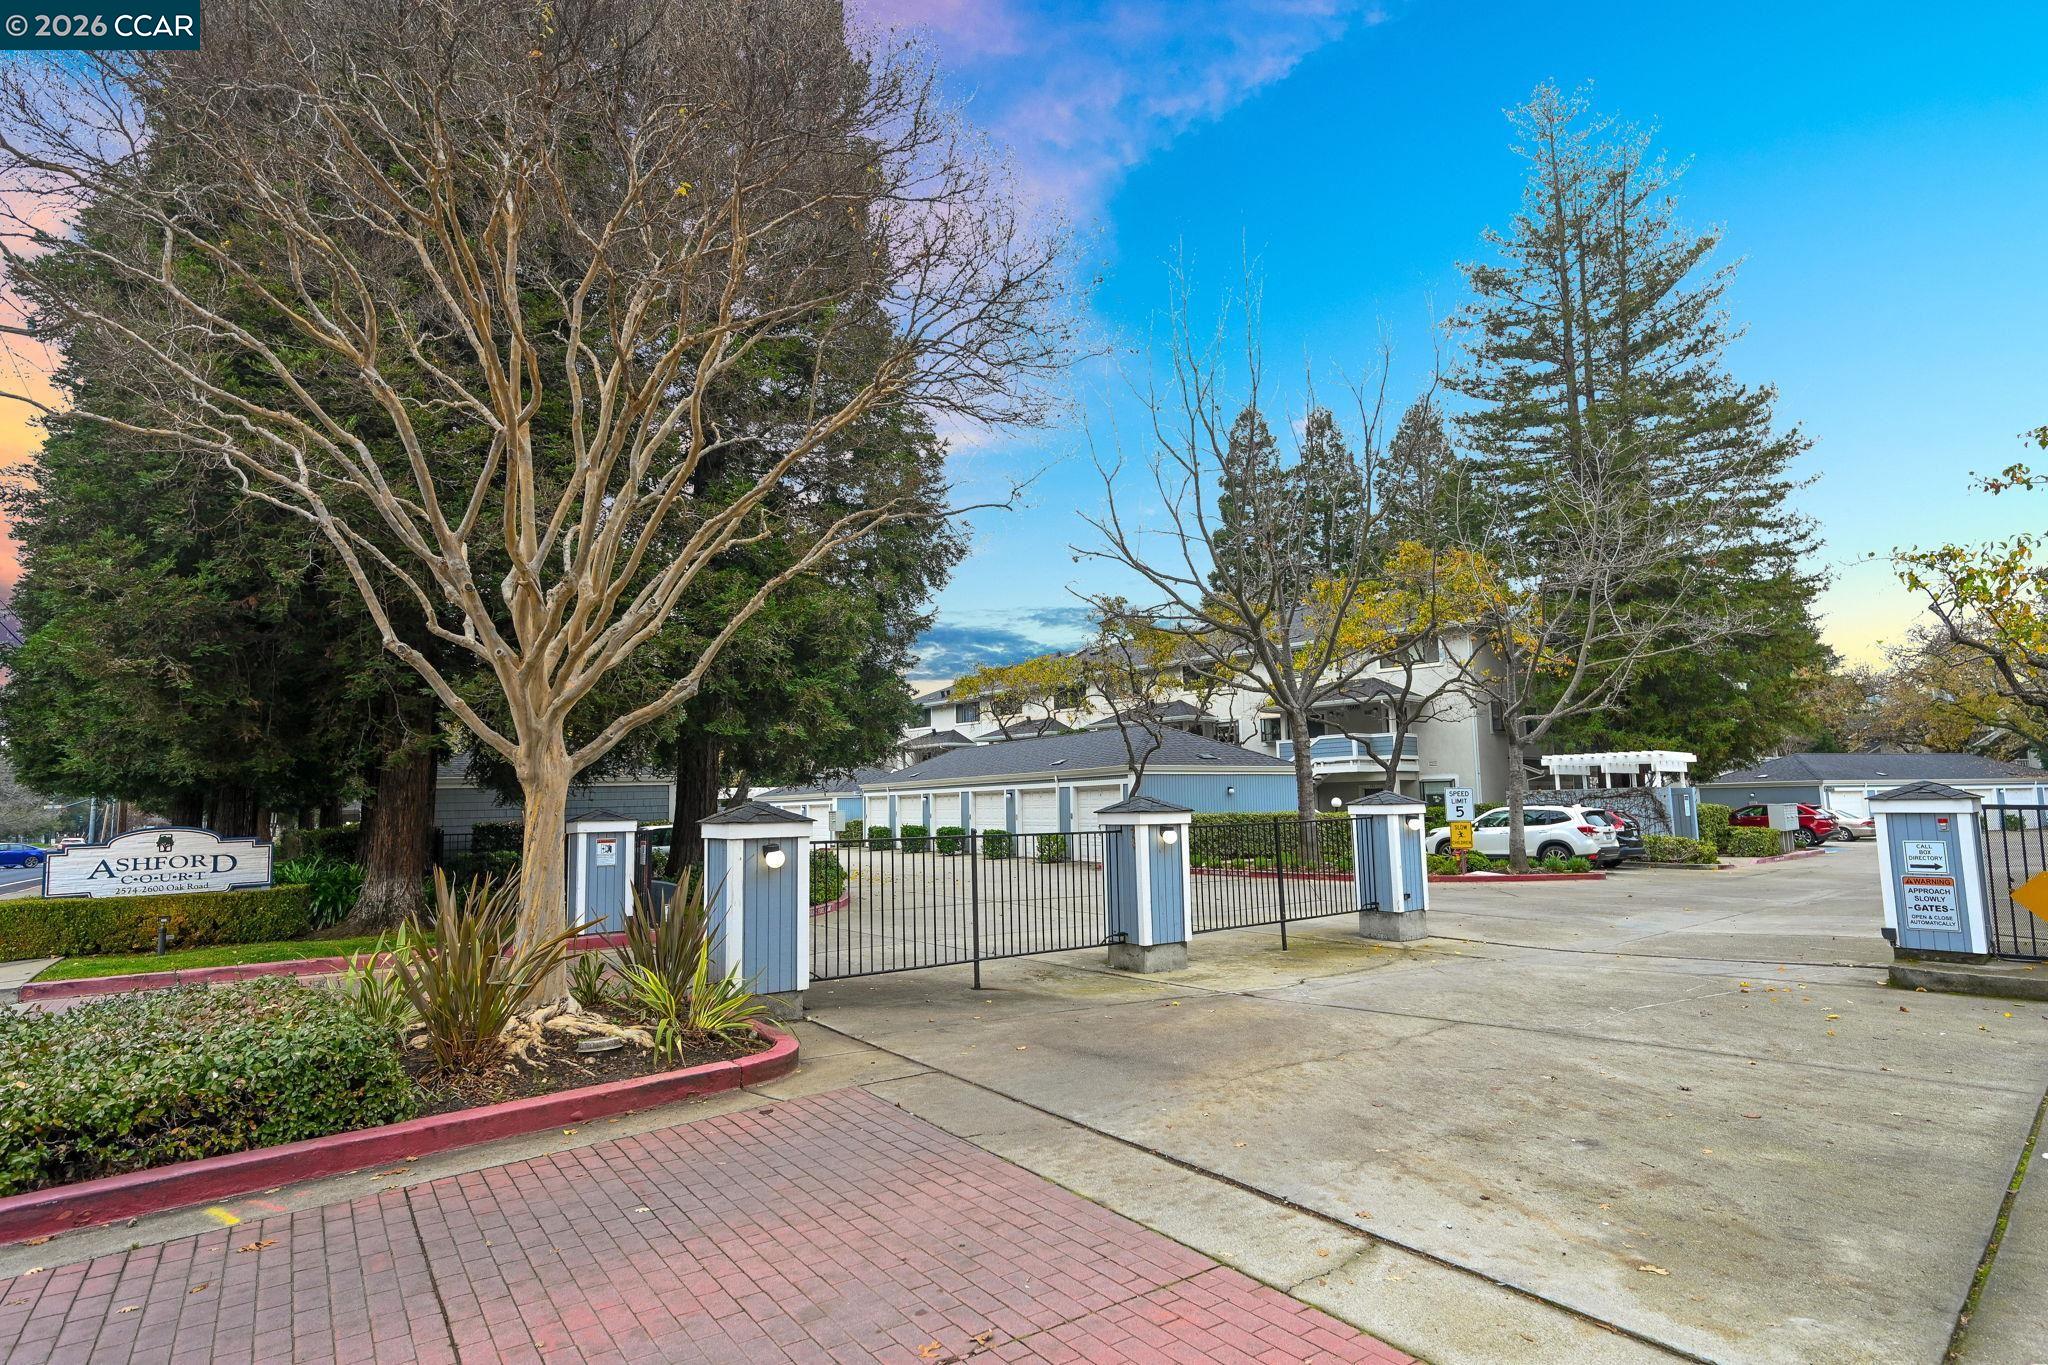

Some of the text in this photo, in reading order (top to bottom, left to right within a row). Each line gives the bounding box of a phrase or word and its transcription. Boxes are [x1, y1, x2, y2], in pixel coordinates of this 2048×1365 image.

[1456, 805, 1464, 817] 5
[87, 854, 237, 880] ASHFORD
[1912, 878, 1951, 886] WARNING
[166, 883, 184, 891] Oak
[187, 882, 209, 890] Road
[1908, 887, 1951, 895] APPROACH
[1914, 895, 1946, 903] SLOWLY
[1910, 919, 1956, 927] AUTOMATICALLY
